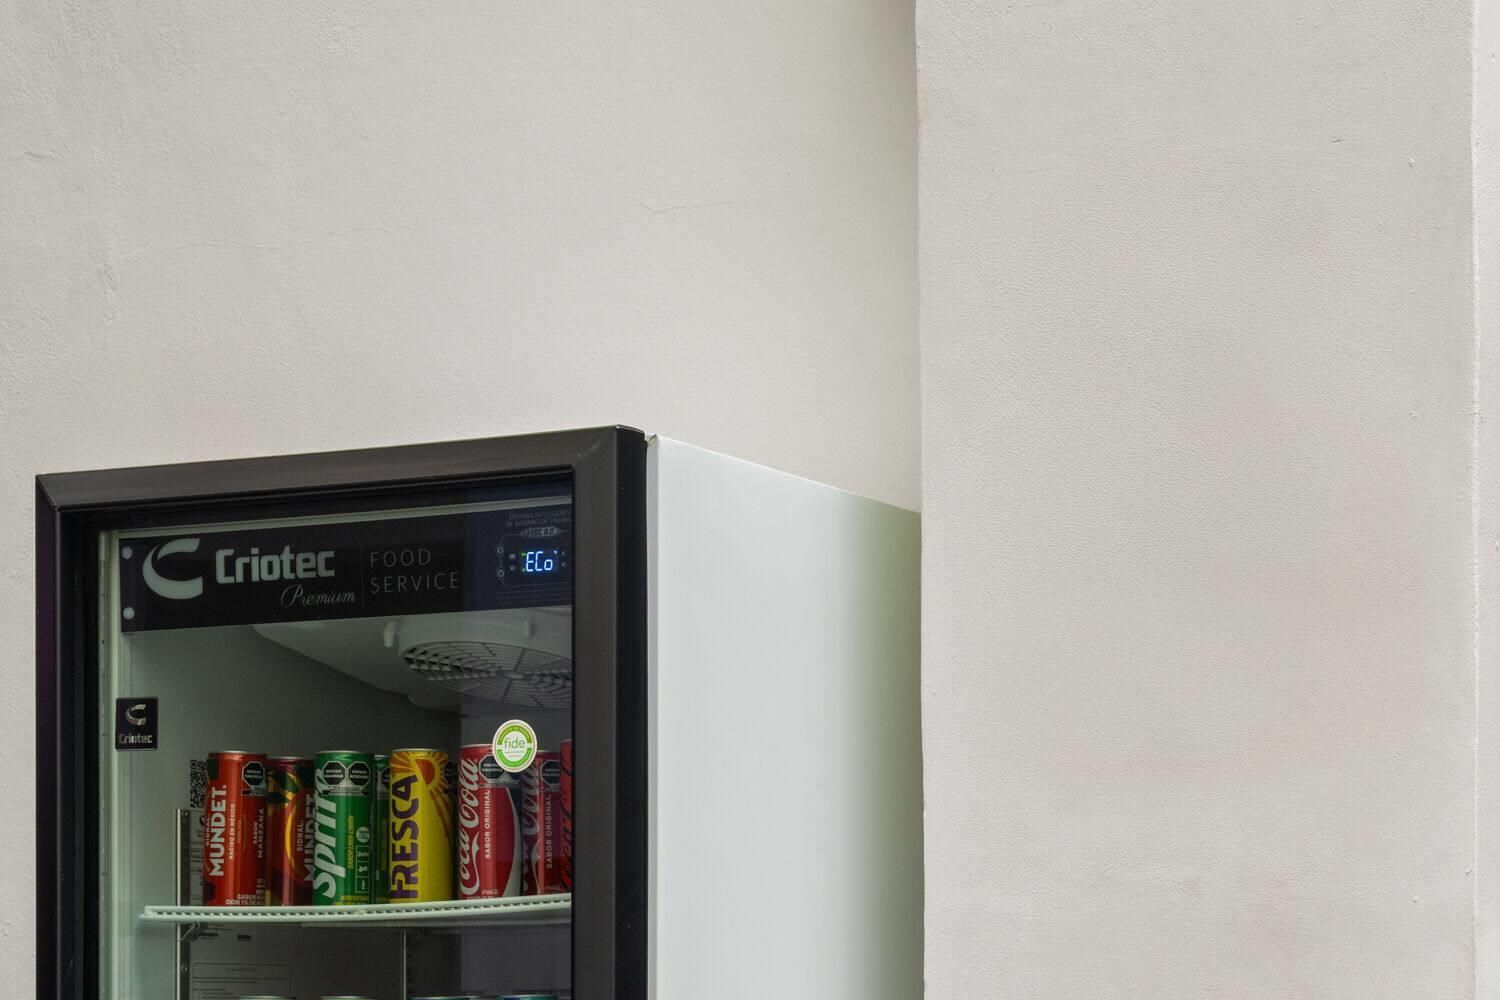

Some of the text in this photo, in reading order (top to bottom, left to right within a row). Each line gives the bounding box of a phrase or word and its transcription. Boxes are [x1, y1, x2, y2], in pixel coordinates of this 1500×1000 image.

[215, 545, 431, 585] Criotec FOOD
[370, 570, 461, 595] SERVICE
[280, 583, 356, 610] Premium
[118, 732, 153, 745] Criotec
[504, 737, 526, 750] fide
[229, 827, 235, 836] EN
[390, 774, 419, 899] FRESCA
